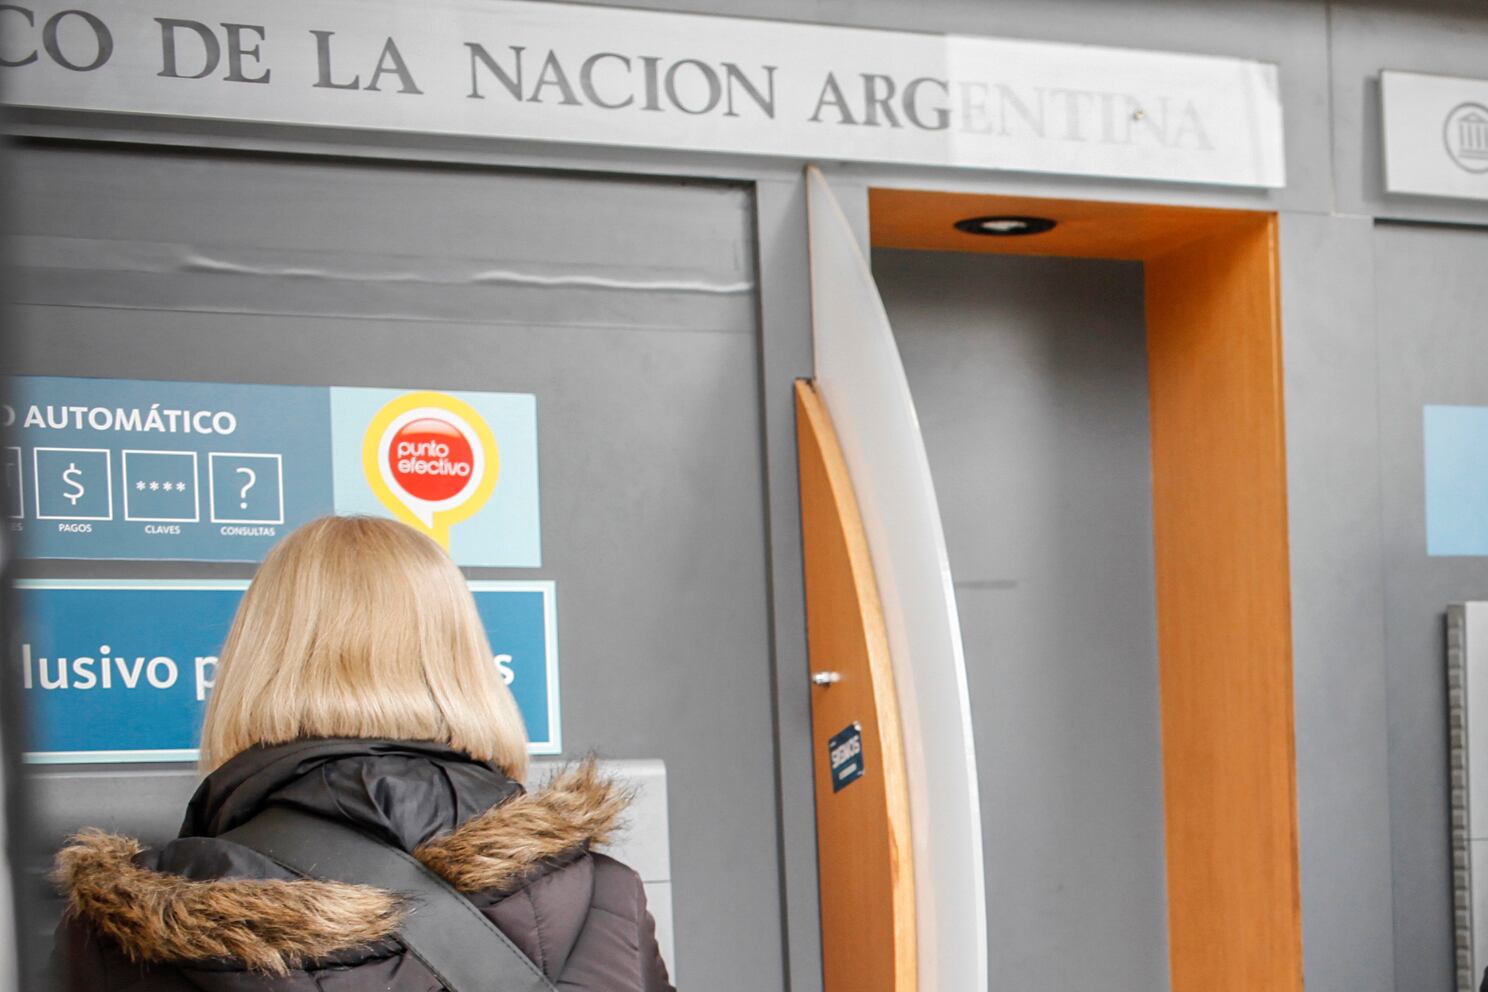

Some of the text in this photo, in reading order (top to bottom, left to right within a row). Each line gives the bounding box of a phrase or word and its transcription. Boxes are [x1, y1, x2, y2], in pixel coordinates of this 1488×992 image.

[153, 17, 271, 84] DE
[309, 30, 424, 95] LA
[463, 41, 778, 119] NACION
[807, 70, 1216, 152] ARGENTINA
[24, 404, 237, 435] AUTOMÁTICO
[397, 440, 449, 458] punto
[397, 456, 471, 477] efectivo
[58, 523, 92, 534] PAGOS
[144, 524, 181, 536] CLAVES
[220, 526, 276, 537] CONSULTAS
